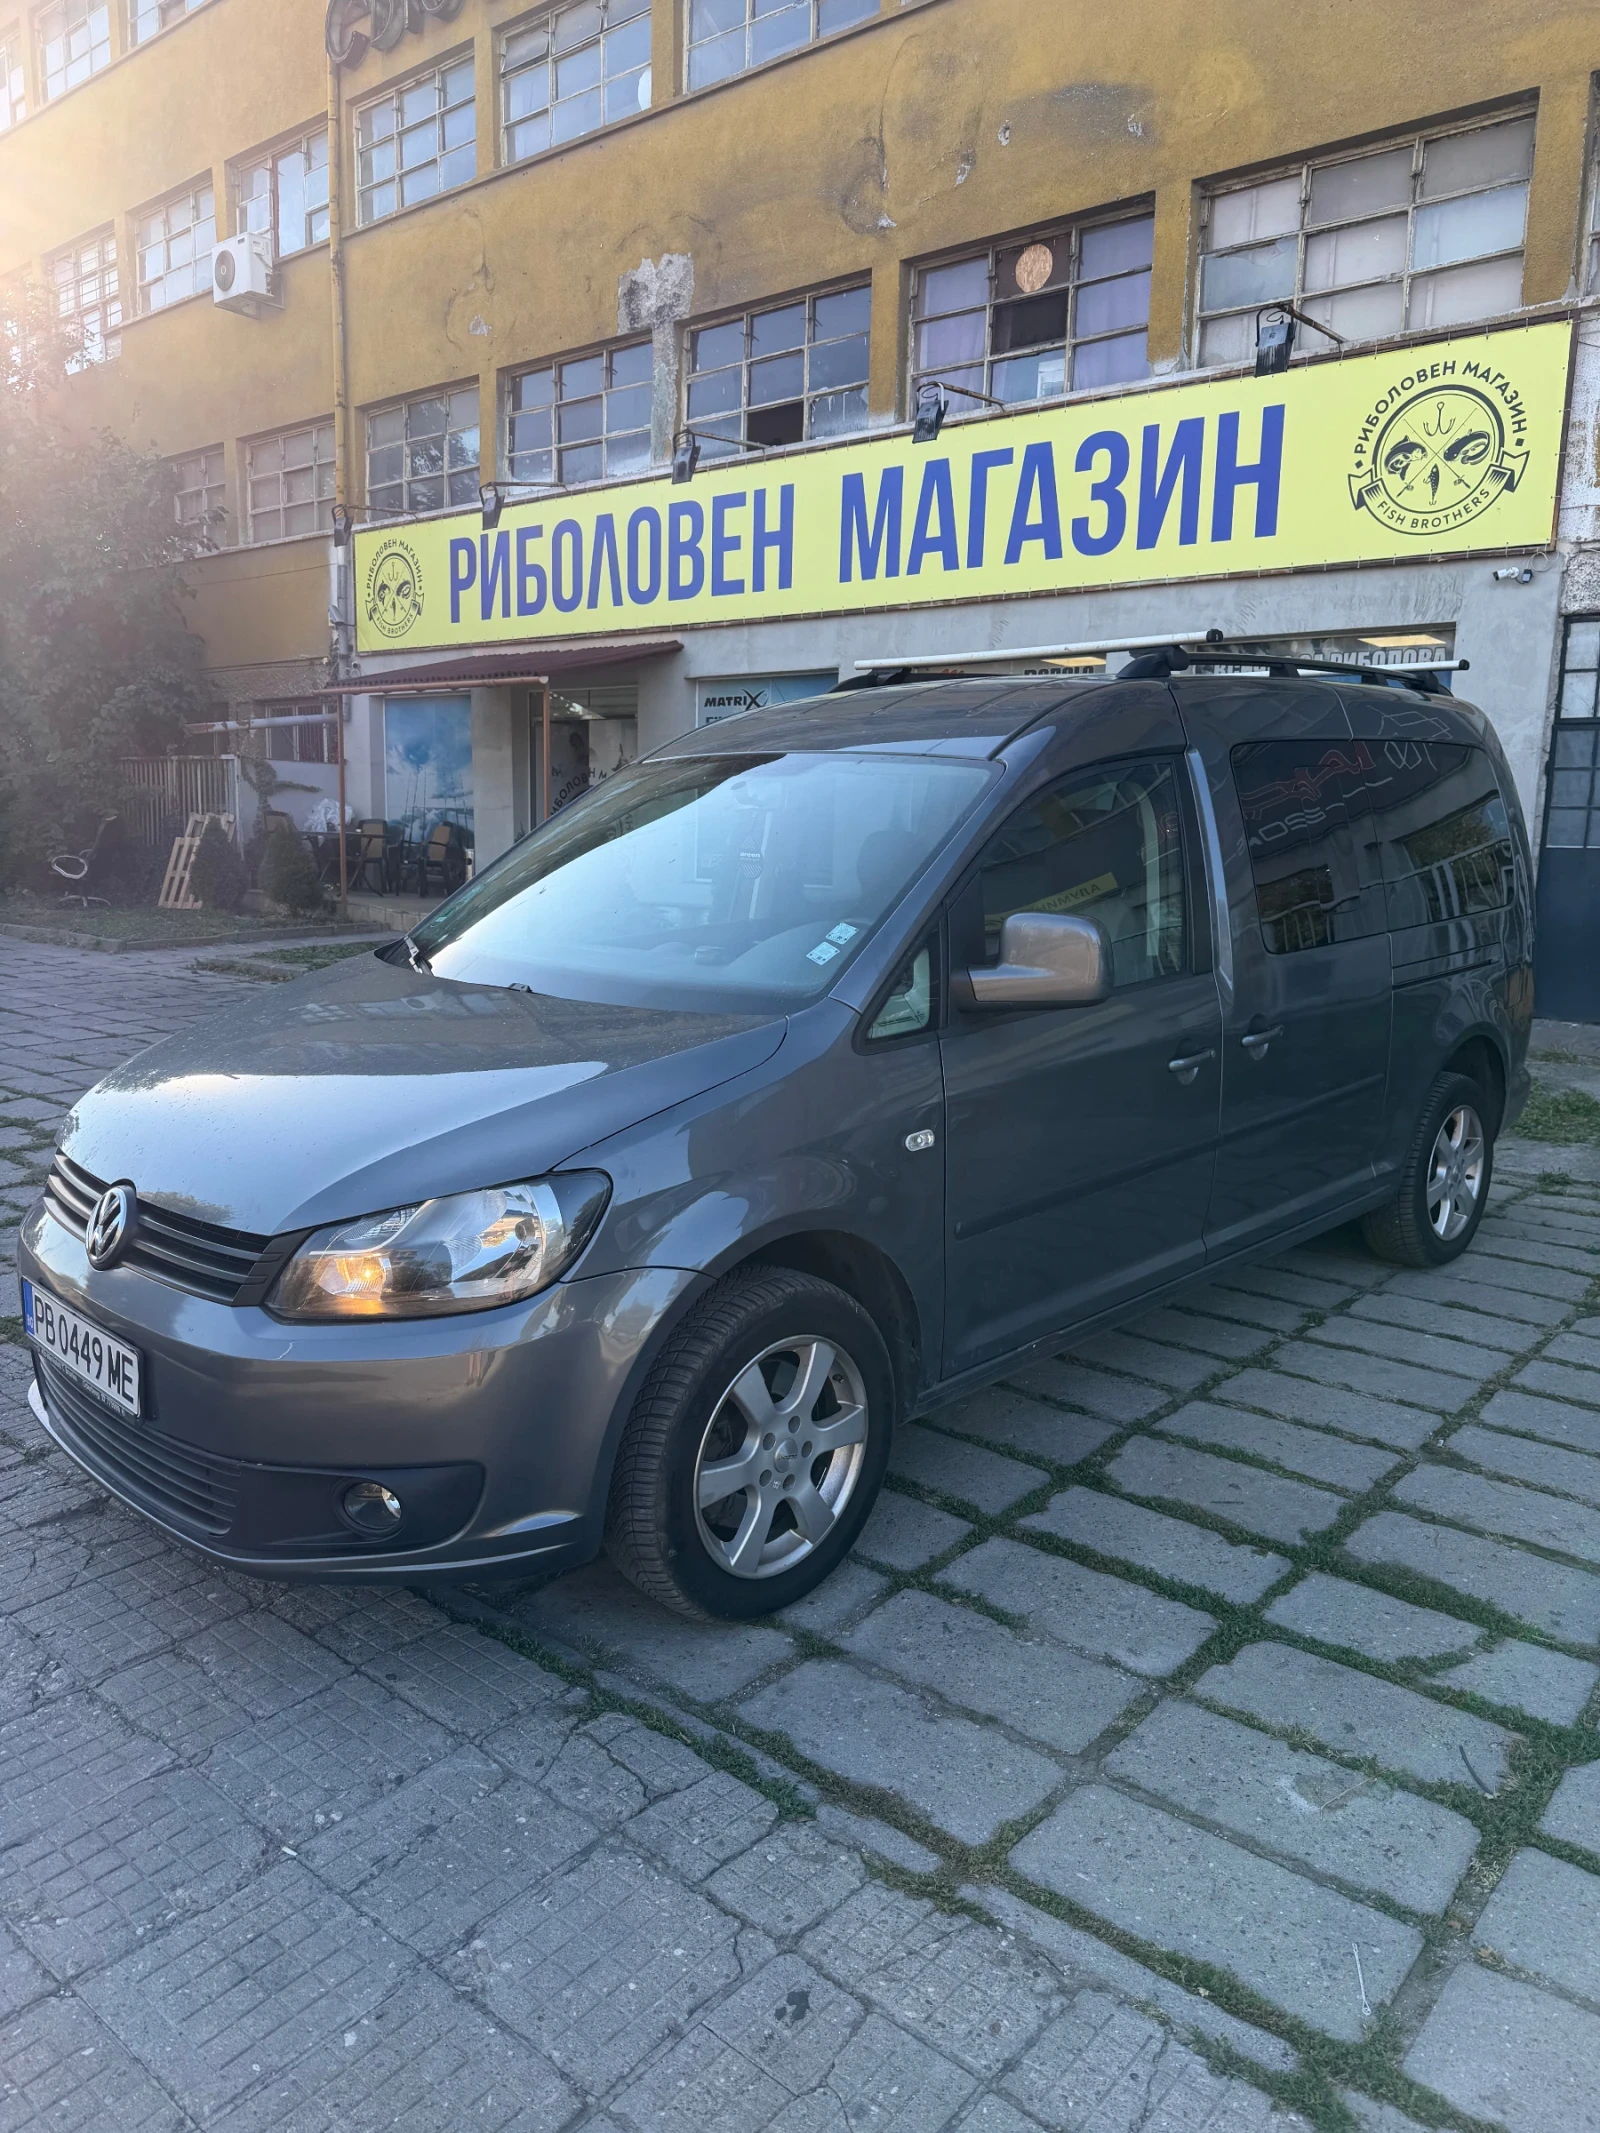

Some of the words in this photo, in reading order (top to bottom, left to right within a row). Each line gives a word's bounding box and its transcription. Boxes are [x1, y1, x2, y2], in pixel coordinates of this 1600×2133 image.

[1353, 360, 1457, 454] РИБОЛОВЕН
[1462, 360, 1528, 434] МАГАЗИН
[449, 482, 796, 625] РИБОЛОВЕН
[839, 403, 1286, 584] МАГАЗИН
[1377, 500, 1406, 525] FISH
[1410, 488, 1490, 529] BROTHERS
[366, 538, 398, 589] РИБОЛОВЕН
[398, 539, 423, 583] МАГАЗИН
[376, 616, 387, 632] FISH
[387, 613, 414, 635] BROTHERS
[704, 688, 768, 711] MATRIX
[34, 1294, 56, 1346] PB
[58, 1314, 103, 1380] 0449
[107, 1344, 134, 1405] ME
